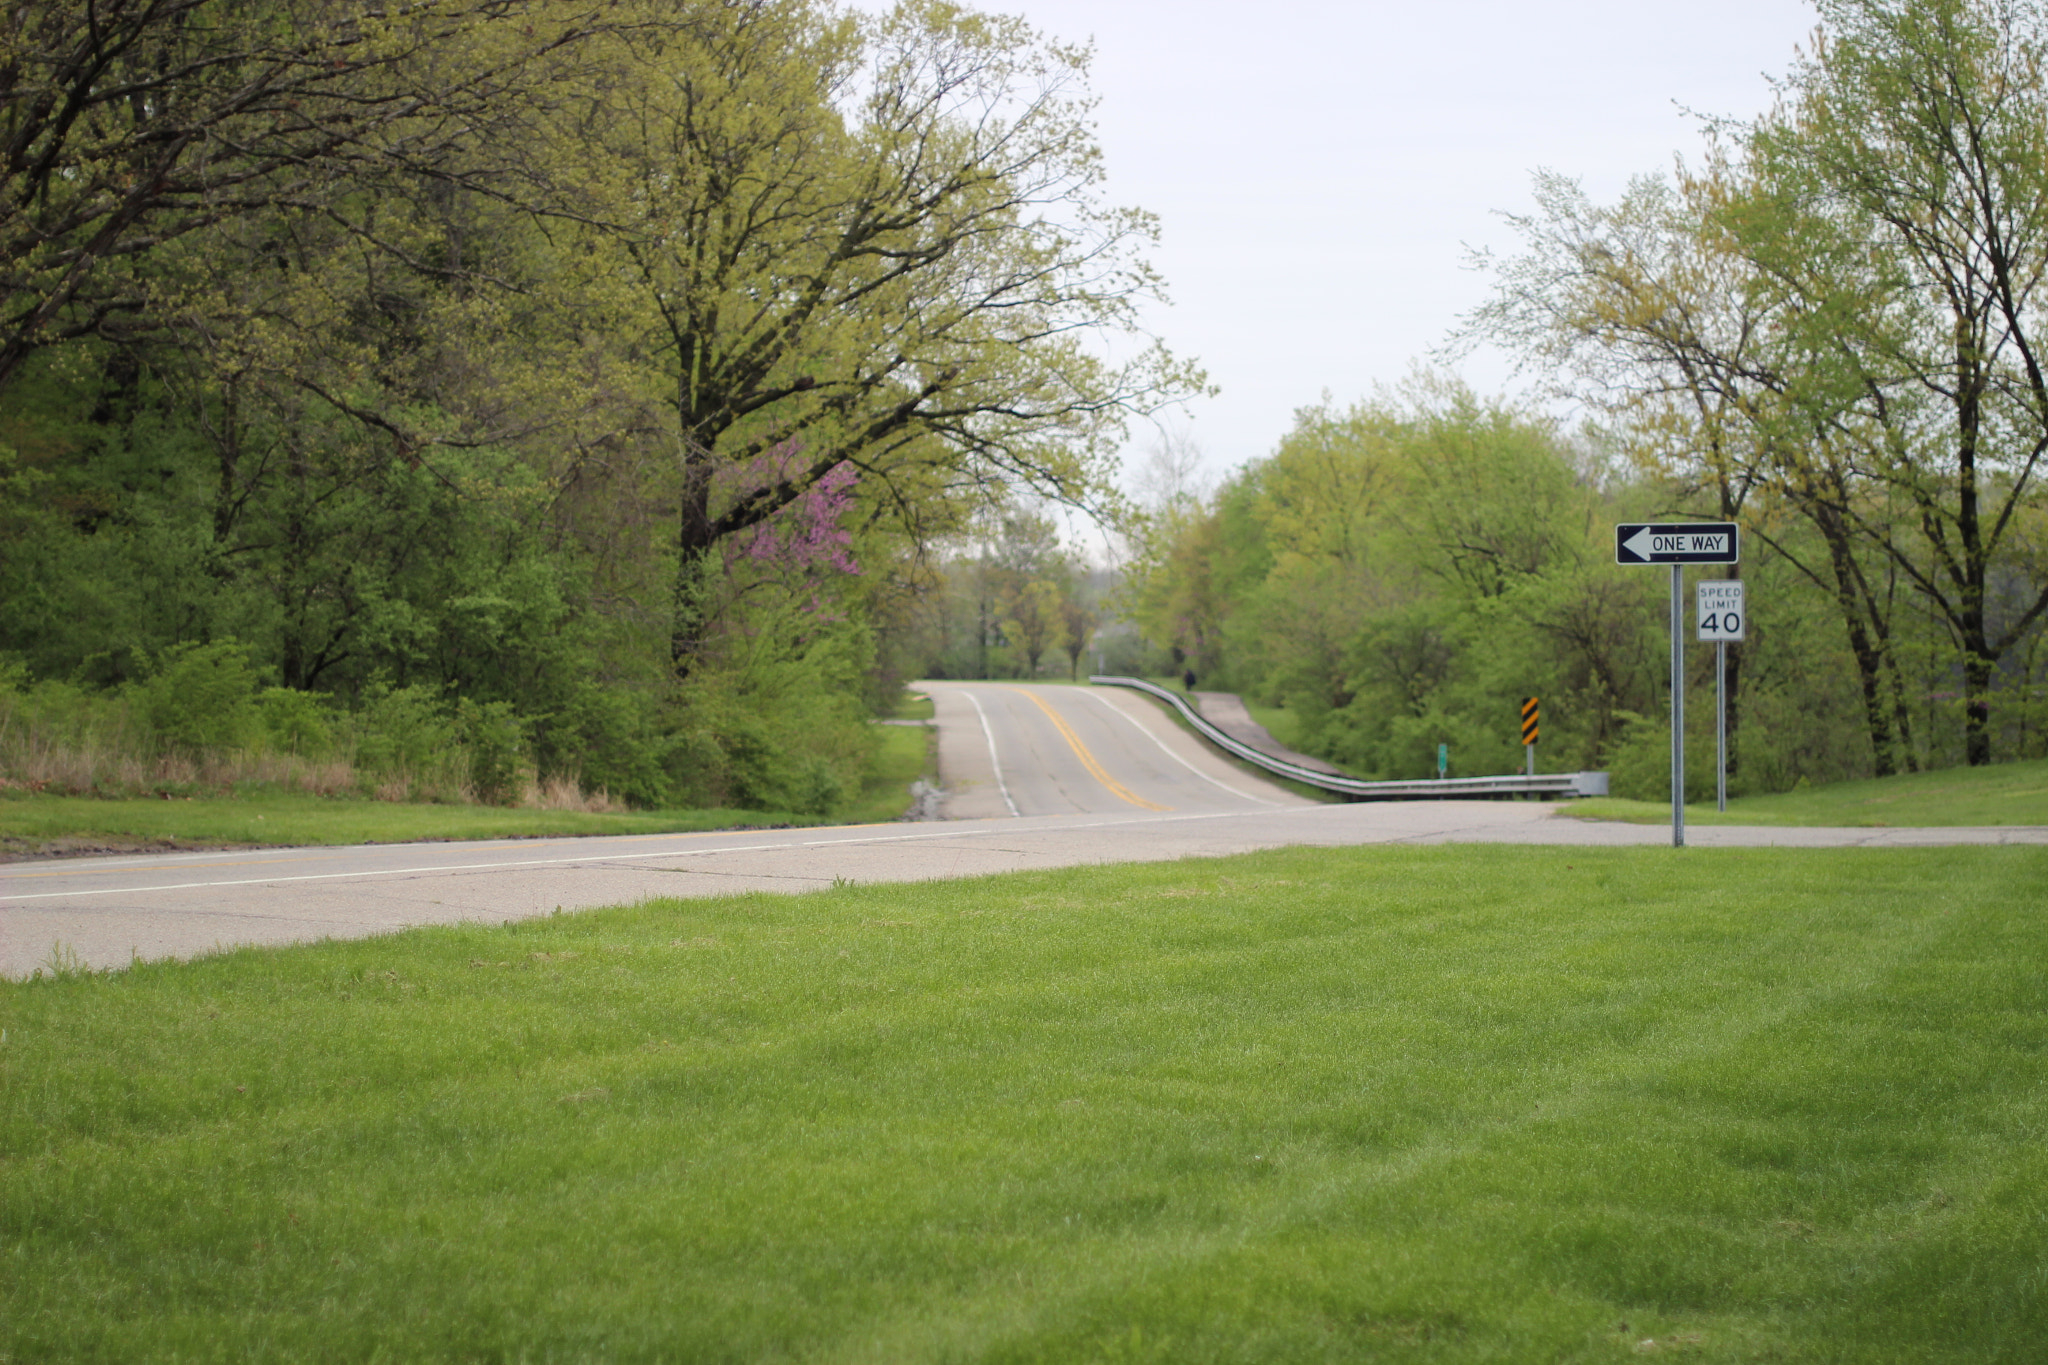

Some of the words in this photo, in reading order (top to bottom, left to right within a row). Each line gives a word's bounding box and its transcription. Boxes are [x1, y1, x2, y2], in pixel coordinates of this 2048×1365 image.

[1653, 536, 1686, 551] ONE
[1692, 536, 1724, 550] WAY
[1700, 588, 1741, 597] SPEED
[1704, 600, 1737, 609] LIMIT
[1700, 612, 1740, 633] 40
